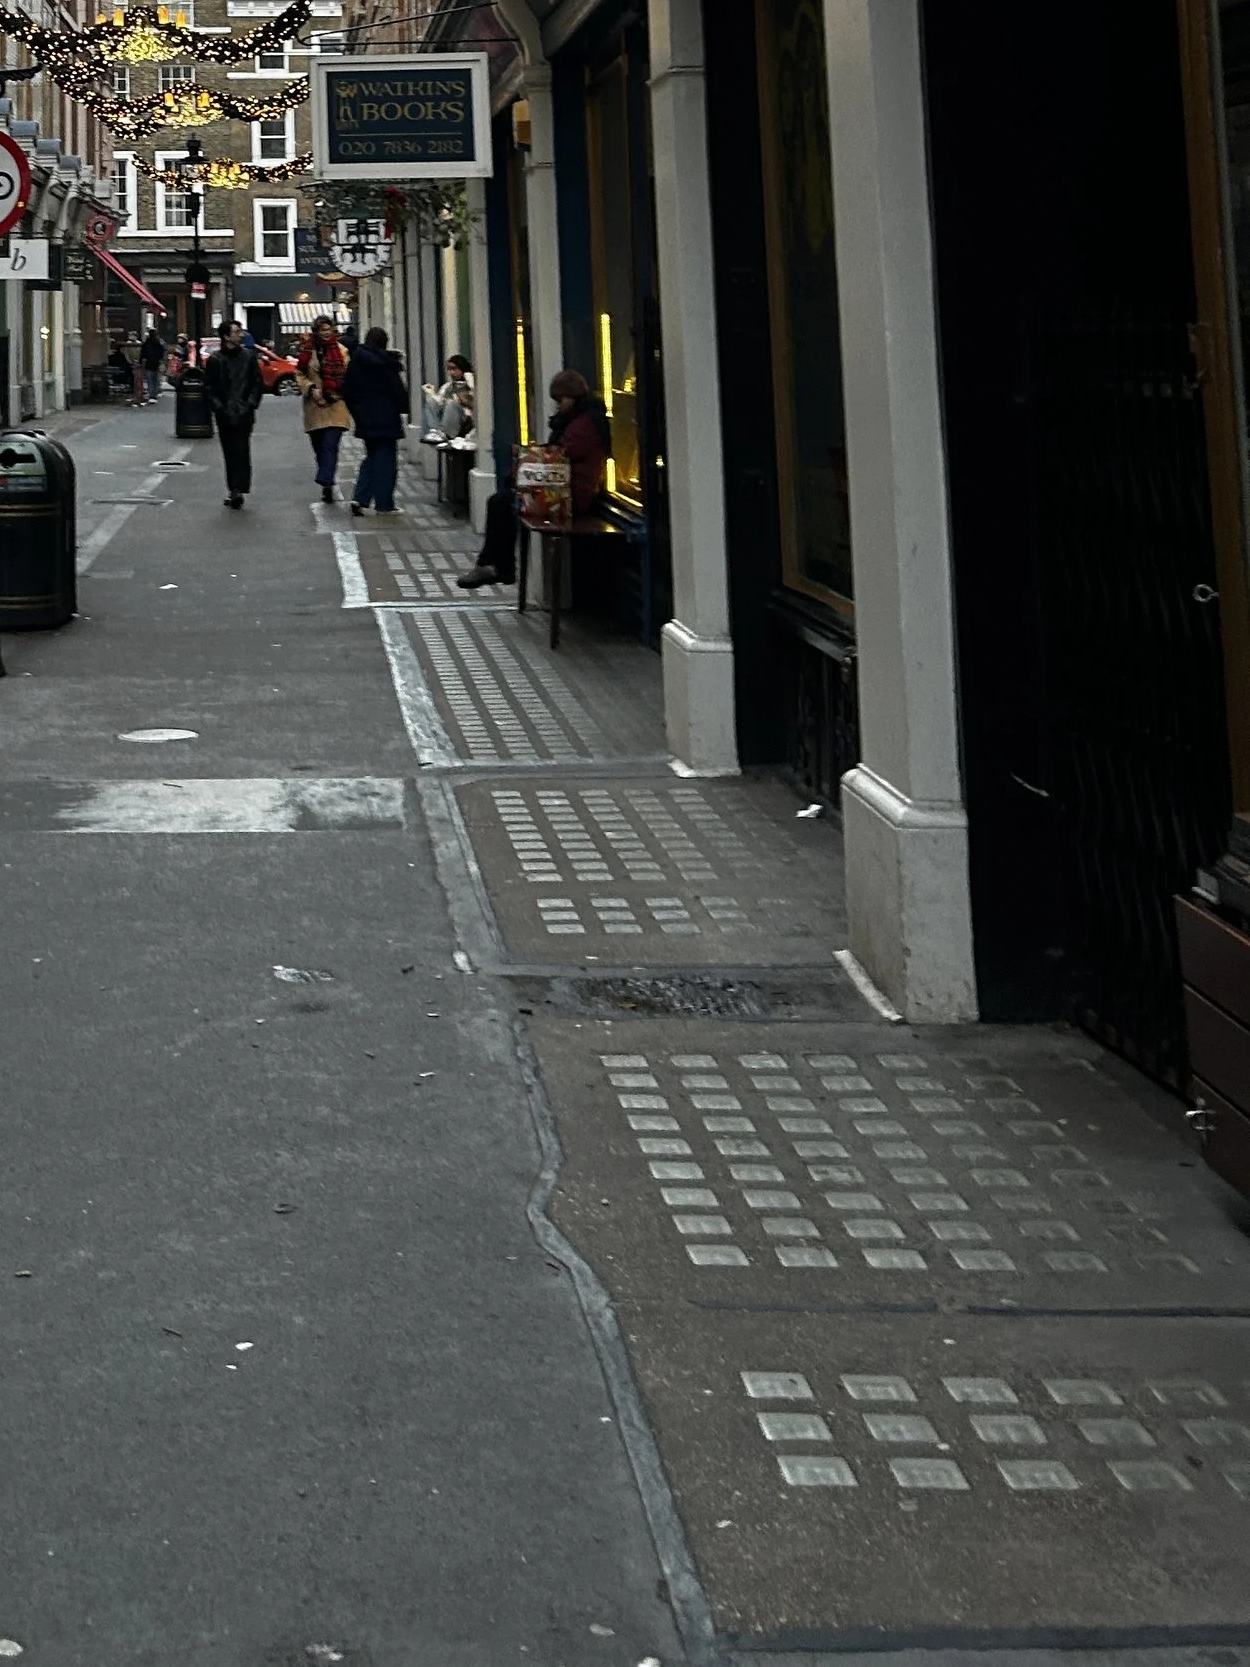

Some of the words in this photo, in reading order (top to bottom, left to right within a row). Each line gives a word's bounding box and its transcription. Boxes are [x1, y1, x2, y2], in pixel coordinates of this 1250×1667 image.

[359, 80, 466, 97] WATKINS
[360, 101, 466, 123] BOOKS
[338, 140, 376, 156] 020
[384, 140, 422, 155] 7836
[427, 139, 464, 155] 2182
